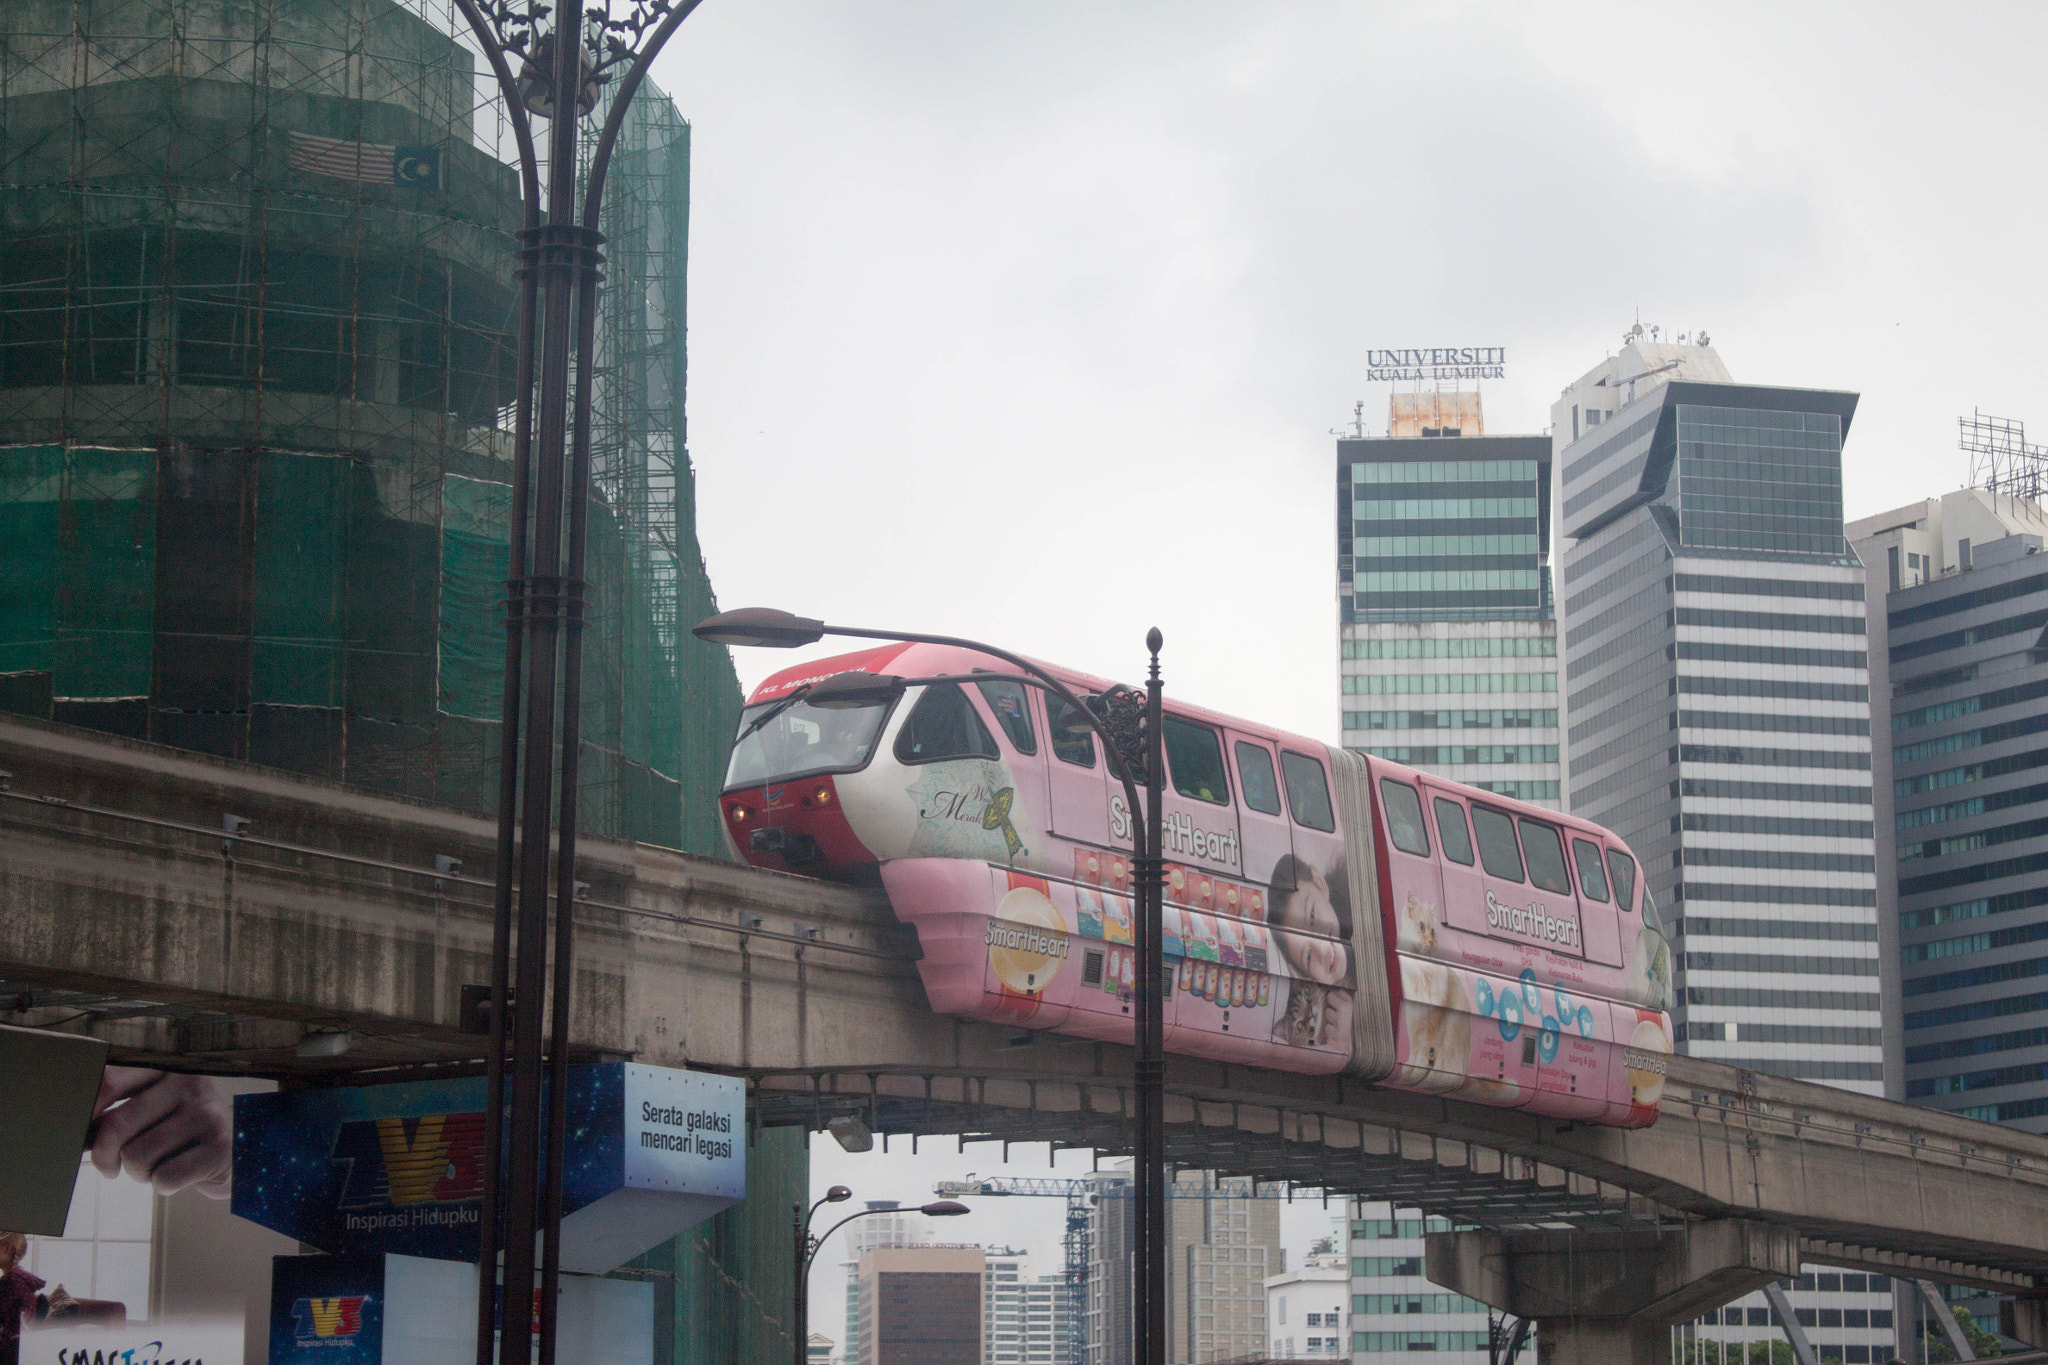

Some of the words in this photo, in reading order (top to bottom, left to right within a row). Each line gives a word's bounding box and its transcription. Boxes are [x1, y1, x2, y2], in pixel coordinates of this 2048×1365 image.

[1366, 347, 1506, 367] UNIVERSITI
[1366, 368, 1424, 381] KUALA
[1433, 366, 1505, 380] LUMPUR
[759, 684, 779, 695] KL
[782, 667, 866, 690] MONOIL
[921, 791, 984, 824] Merak
[1111, 795, 1238, 866] SrtHeart
[1486, 890, 1579, 948] SmartHeart
[984, 918, 1069, 959] SmartHeart
[642, 1101, 683, 1126] Serata
[687, 1110, 731, 1133] galaksi
[641, 1131, 692, 1153] mencari
[696, 1134, 732, 1160] legasi
[346, 1210, 408, 1233] Inspirasi
[412, 1206, 478, 1229] Hidupku
[296, 1340, 323, 1348] Inspirasi
[324, 1338, 354, 1348] Hidupku
